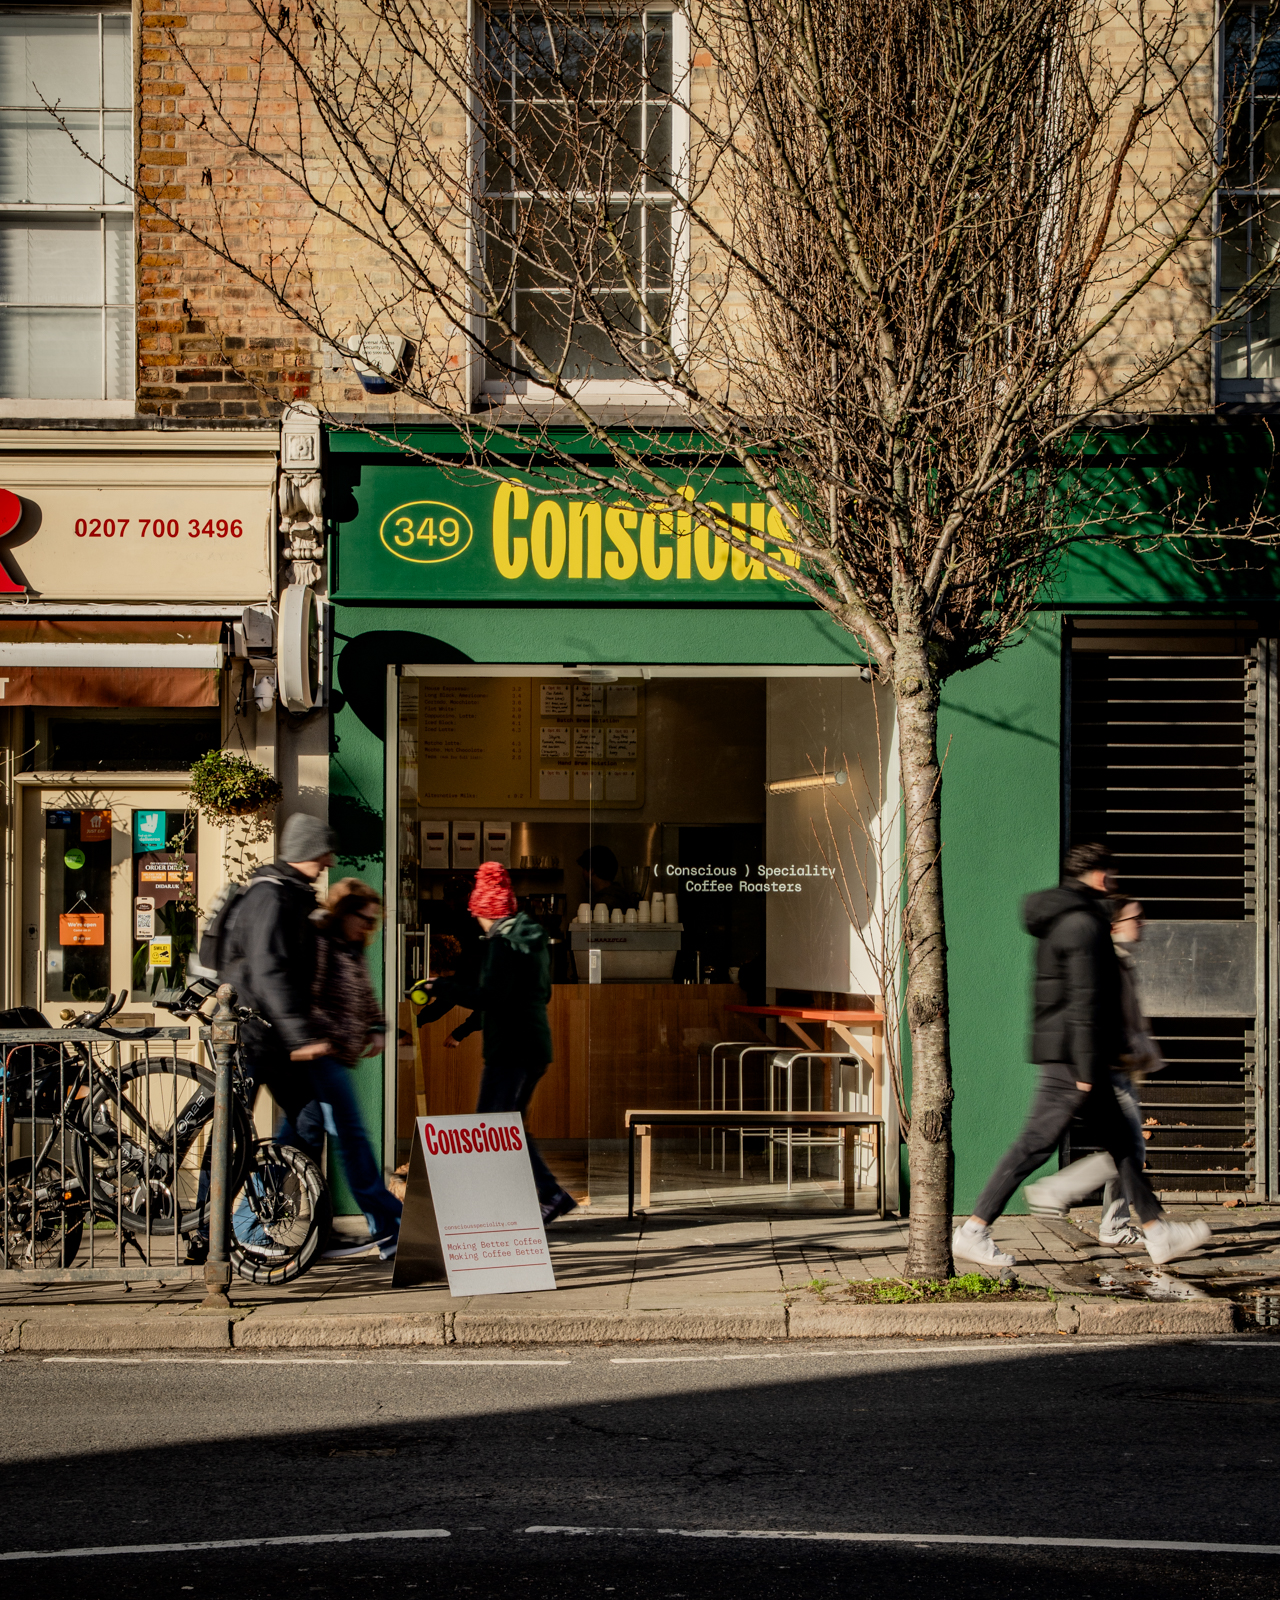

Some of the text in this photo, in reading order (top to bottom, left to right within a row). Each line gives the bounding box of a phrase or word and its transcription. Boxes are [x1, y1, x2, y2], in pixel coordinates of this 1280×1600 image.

[74, 518, 244, 538] 0207 700 3496
[394, 517, 460, 547] 349
[492, 477, 801, 582] Conscious
[666, 864, 737, 876] Conscious
[757, 864, 836, 879] Speciality
[686, 880, 802, 892] Coffee Roasters
[184, 1094, 206, 1124] A2B
[425, 1122, 523, 1155] Conscious
[444, 1221, 517, 1231] consciousspeciality.com
[447, 1238, 543, 1252] Making Better Coffee
[449, 1248, 544, 1261] Making Coffee Better
